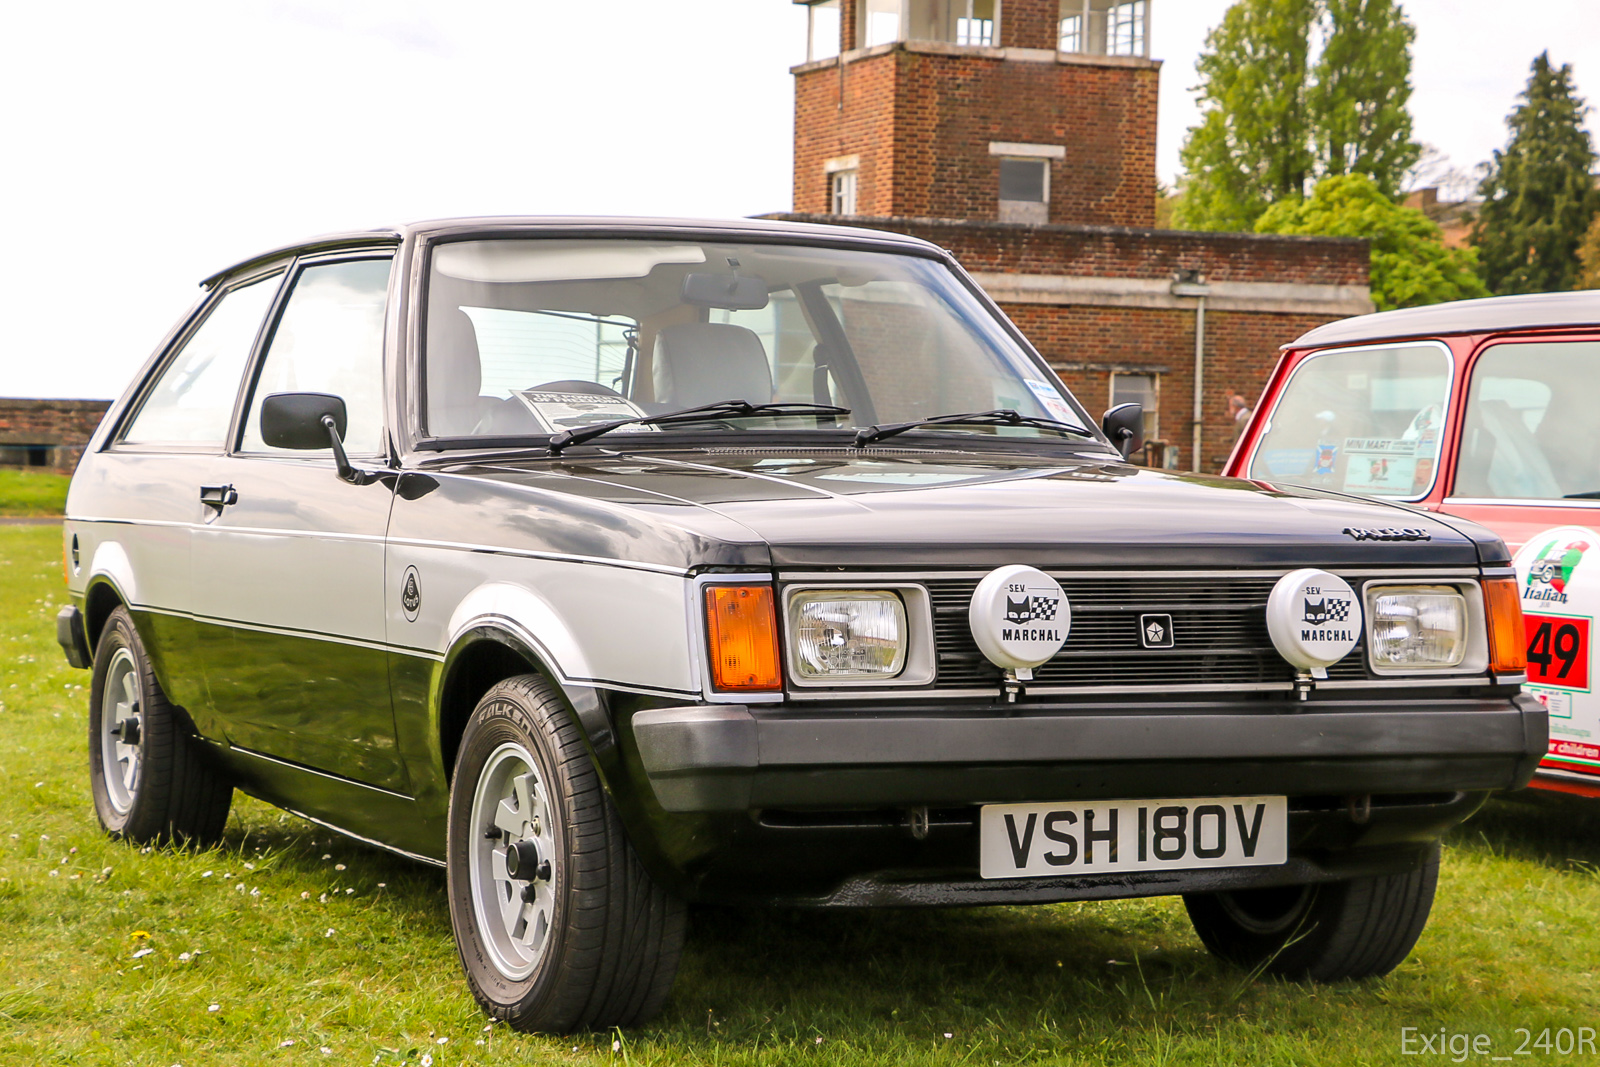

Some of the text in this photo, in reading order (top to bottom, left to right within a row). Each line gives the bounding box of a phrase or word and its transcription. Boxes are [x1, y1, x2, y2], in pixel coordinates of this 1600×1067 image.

[1345, 439, 1365, 449] MINI
[1366, 440, 1392, 450] MART
[1342, 527, 1431, 541] TALBOT
[1523, 586, 1568, 604] Italian
[1002, 629, 1060, 641] MARCHAL
[1301, 630, 1353, 641] MARCHAL
[1527, 622, 1580, 679] 49
[476, 702, 532, 737] FALKEN
[1557, 740, 1599, 758] children
[1003, 803, 1266, 869] VSH 180V
